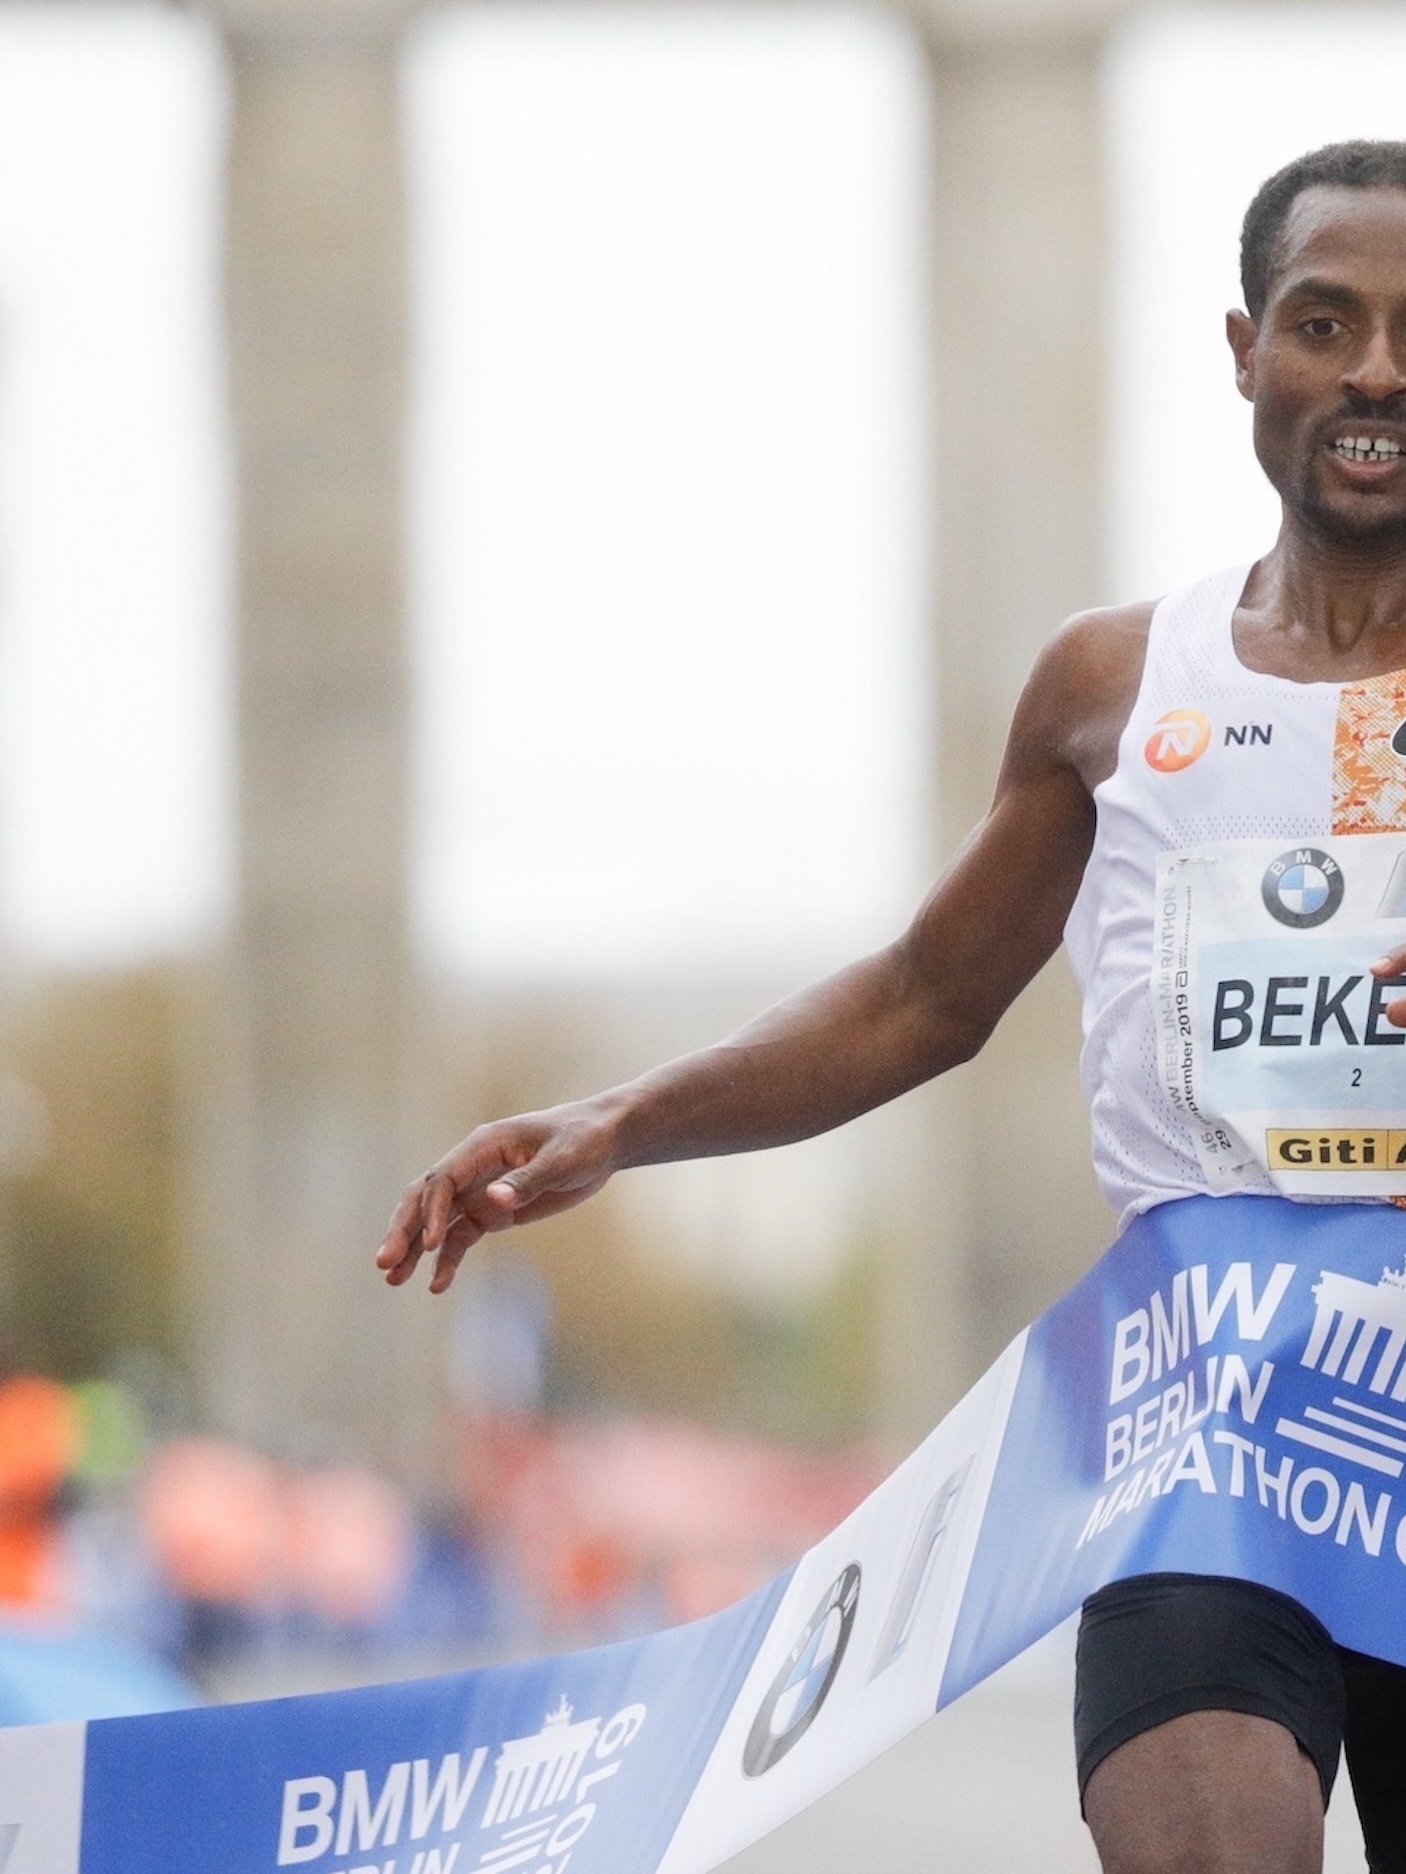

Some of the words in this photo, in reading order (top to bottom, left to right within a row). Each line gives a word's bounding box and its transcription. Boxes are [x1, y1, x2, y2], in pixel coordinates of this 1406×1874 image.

[1224, 724, 1272, 746] NN
[1270, 850, 1338, 876] BMW
[1175, 994, 1192, 1036] 2019
[1351, 1068, 1362, 1087] 2
[1279, 1137, 1375, 1164] Giti
[1109, 1262, 1297, 1405] BMW
[1104, 1354, 1275, 1483] BERLIN
[1076, 1431, 1393, 1557] MARATHON
[276, 1746, 489, 1866] BMW
[547, 1703, 647, 1857] 019
